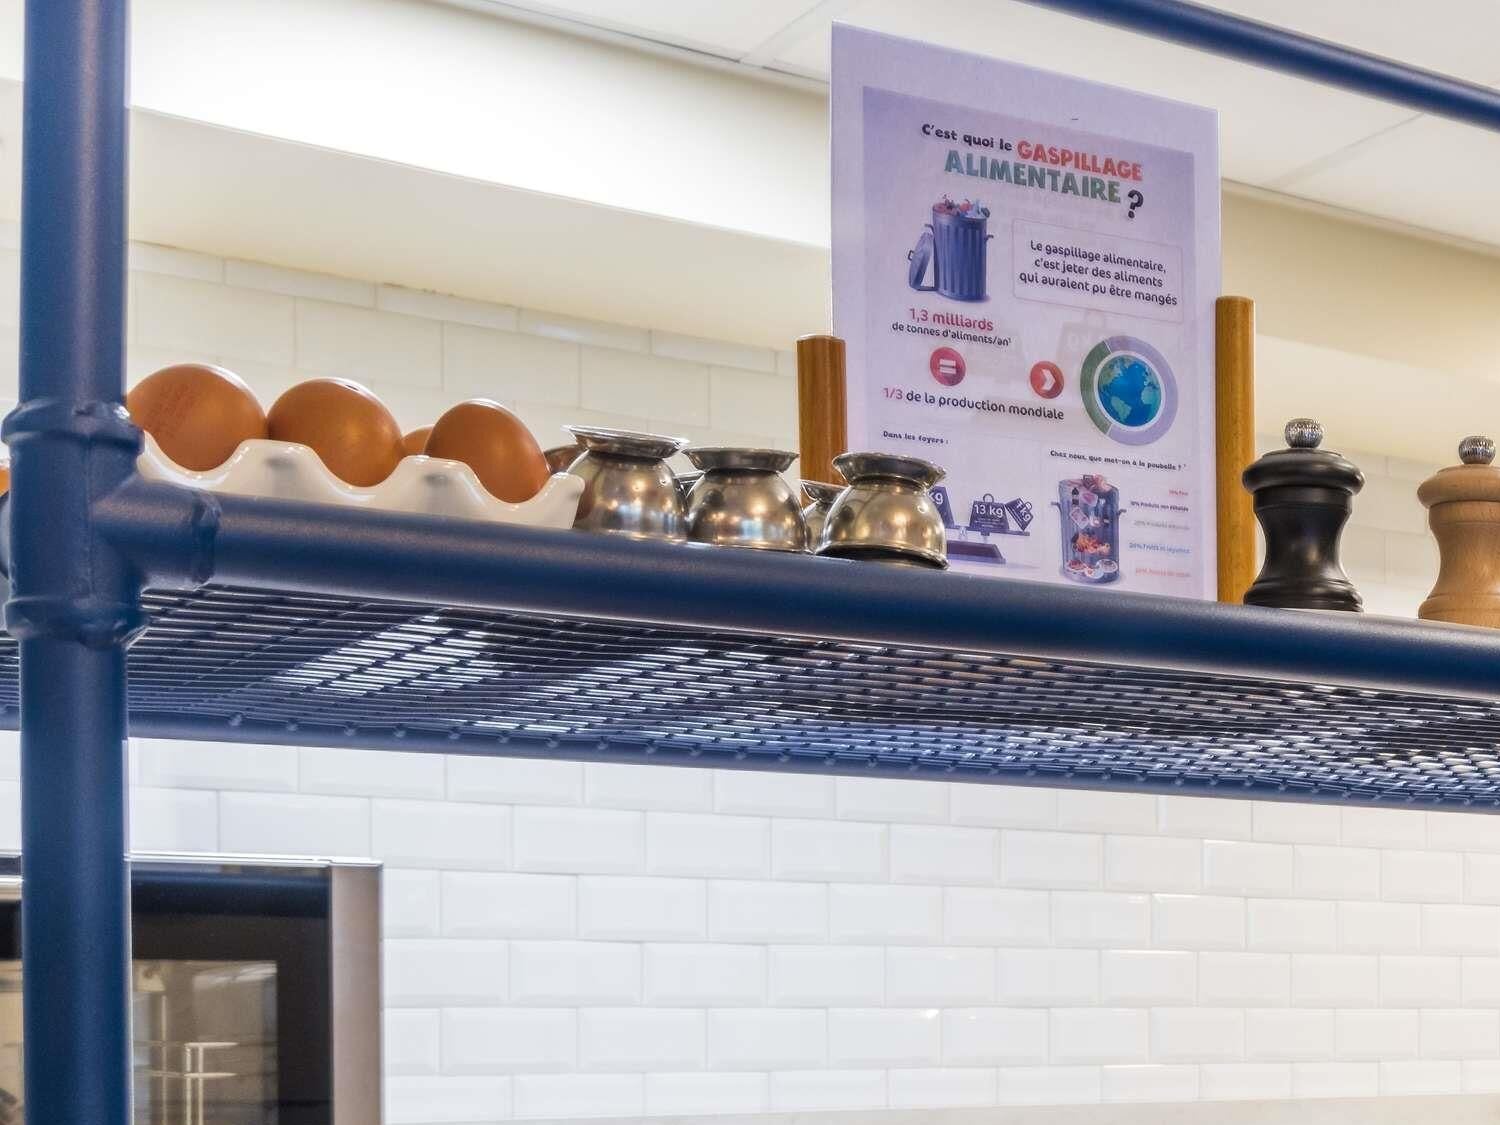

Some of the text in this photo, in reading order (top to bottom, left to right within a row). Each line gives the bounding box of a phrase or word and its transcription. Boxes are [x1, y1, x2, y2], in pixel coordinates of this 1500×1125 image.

[922, 123, 1144, 181] C'est quoi le GASPILLAGE
[945, 149, 1144, 219] ALIMENTAIRE ?
[1030, 240, 1166, 273] Le gaspillage alimentaire,
[1034, 258, 1163, 288] c'est jeter des aliments
[1019, 272, 1178, 306] qui auraient pu être mangés
[891, 321, 904, 331] de
[907, 324, 940, 337] tonnes
[909, 308, 994, 331] 1,3 milliards
[882, 387, 1065, 420] 1/3 de la production mondiale
[883, 430, 902, 439] Dans
[1050, 450, 1067, 458] Chez
[1104, 457, 1130, 466] met-on
[1147, 462, 1176, 471] poubelle
[974, 504, 1003, 519] 13 kg
